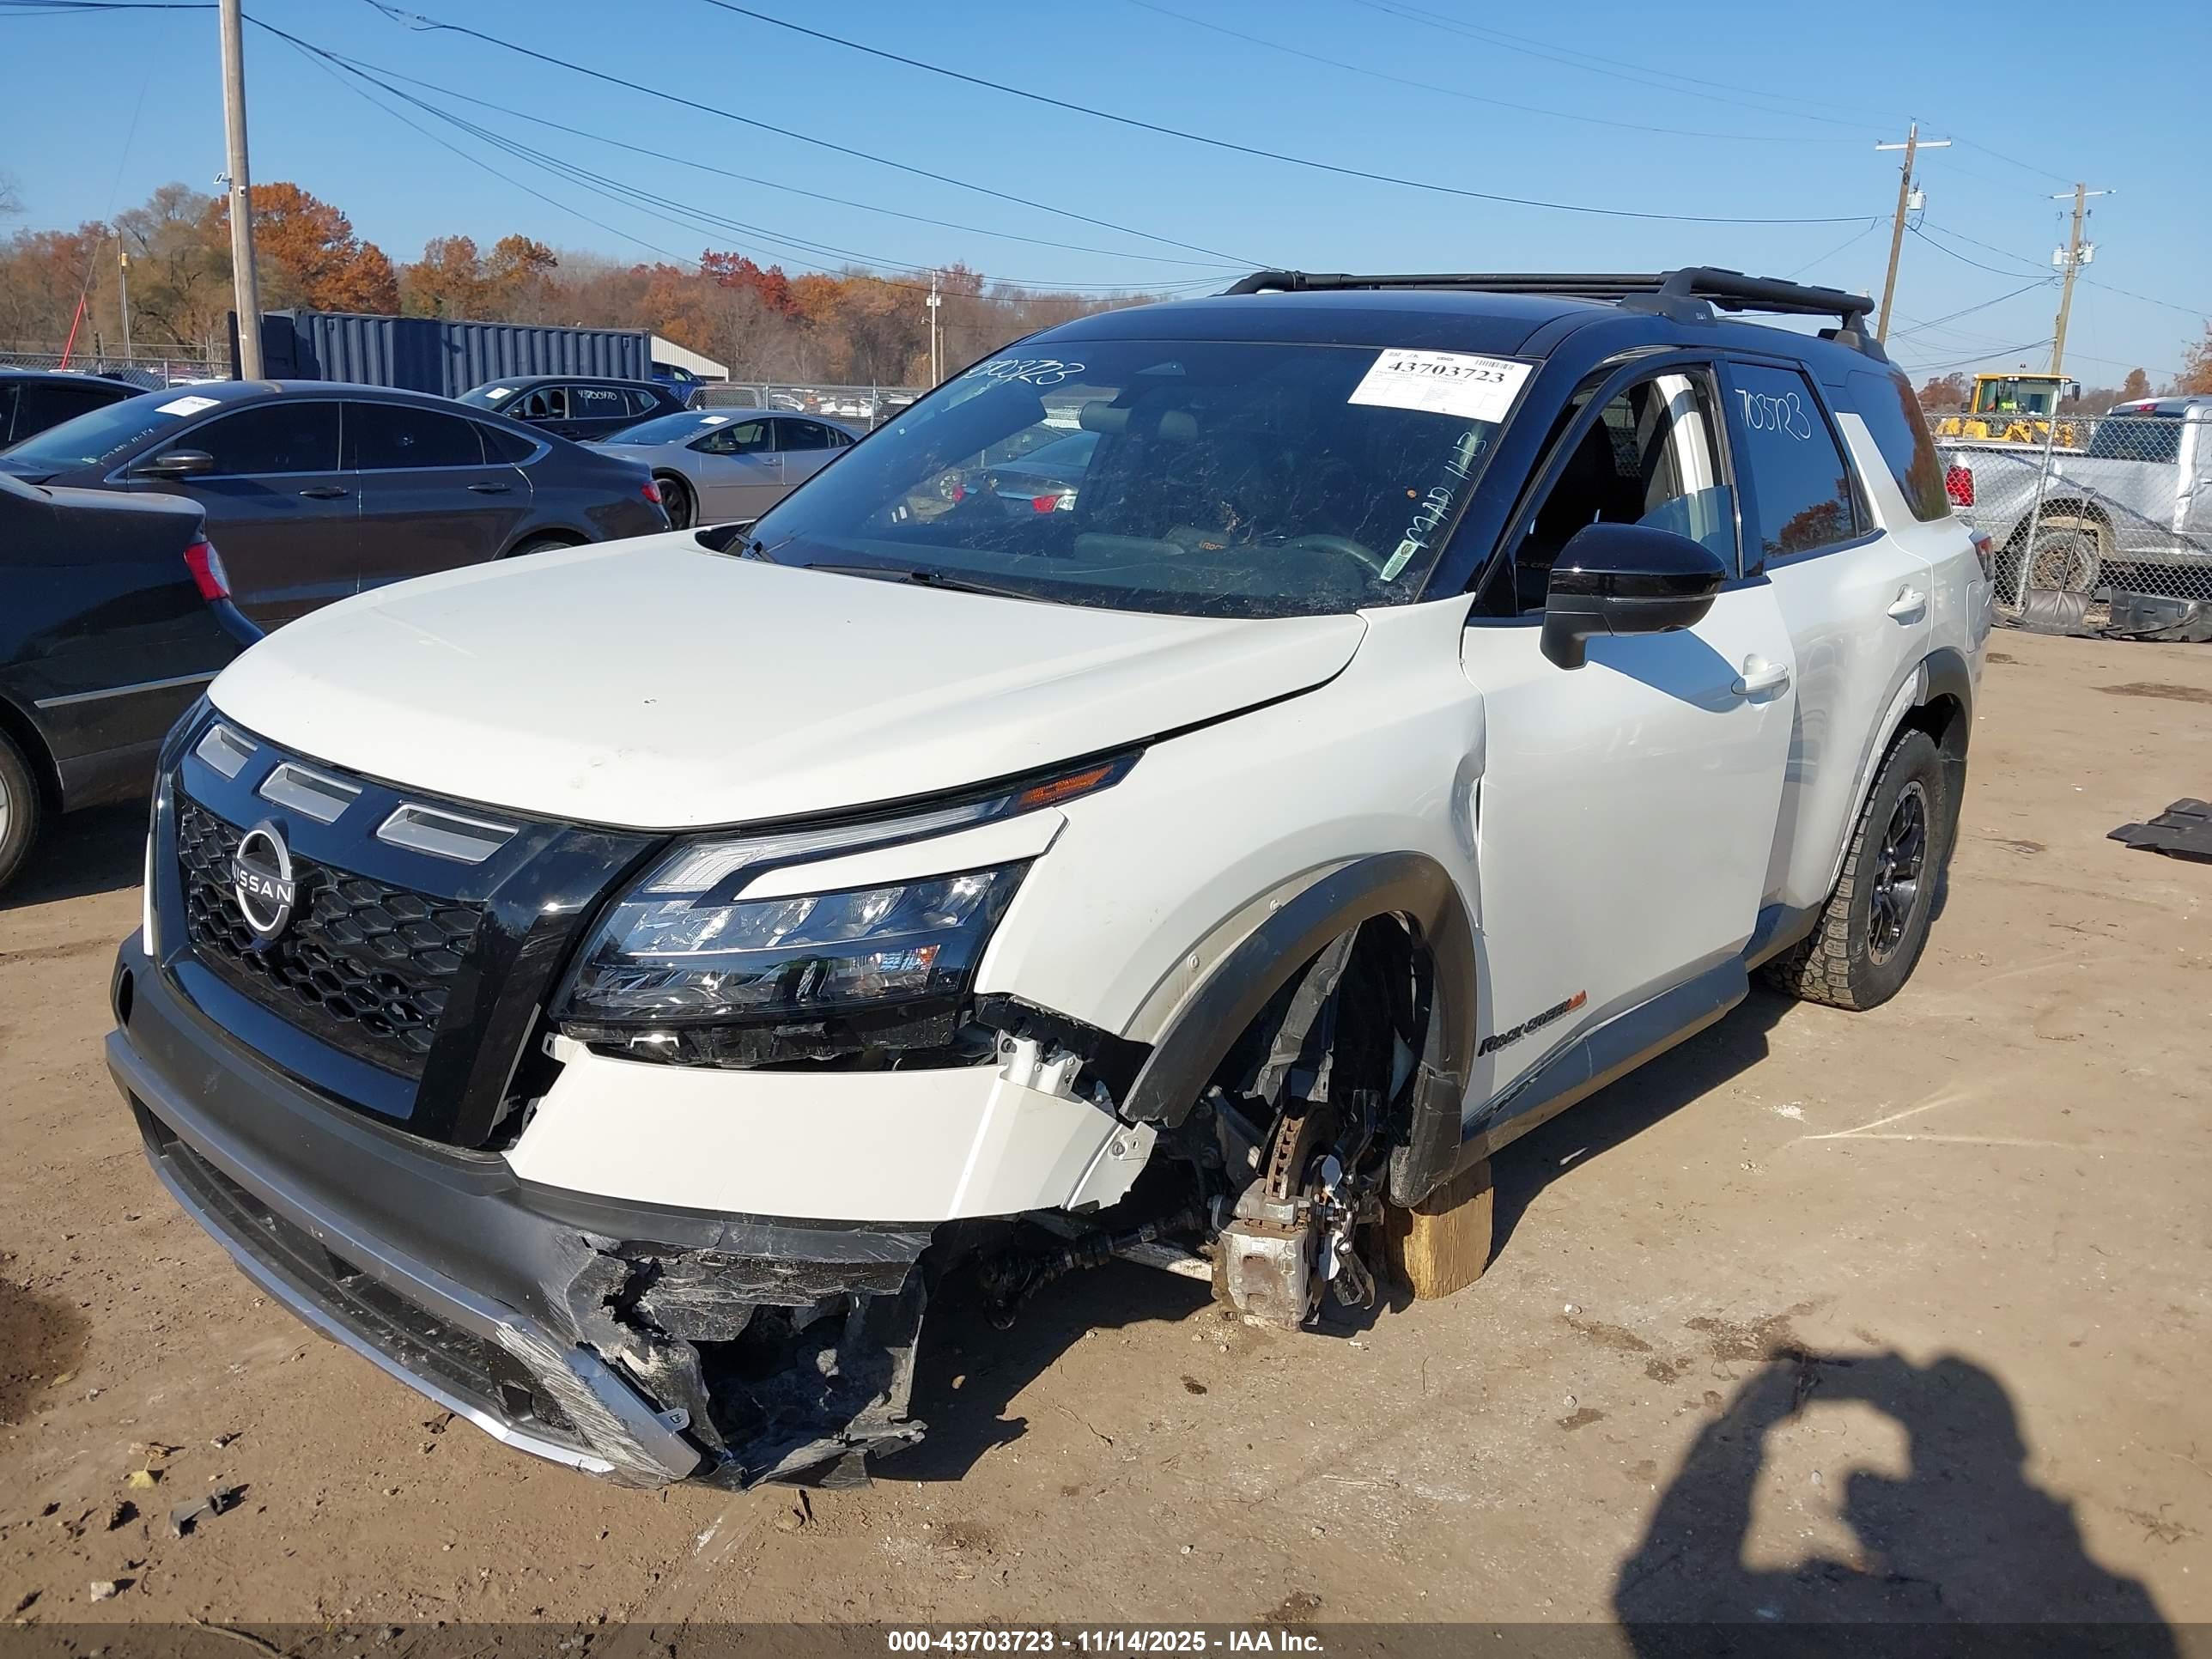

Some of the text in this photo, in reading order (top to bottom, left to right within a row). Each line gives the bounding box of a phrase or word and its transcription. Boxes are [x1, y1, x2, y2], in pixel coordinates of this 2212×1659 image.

[1388, 361, 1505, 383] 43703723
[1734, 388, 1811, 441] 703723
[231, 860, 292, 903] NISSAN
